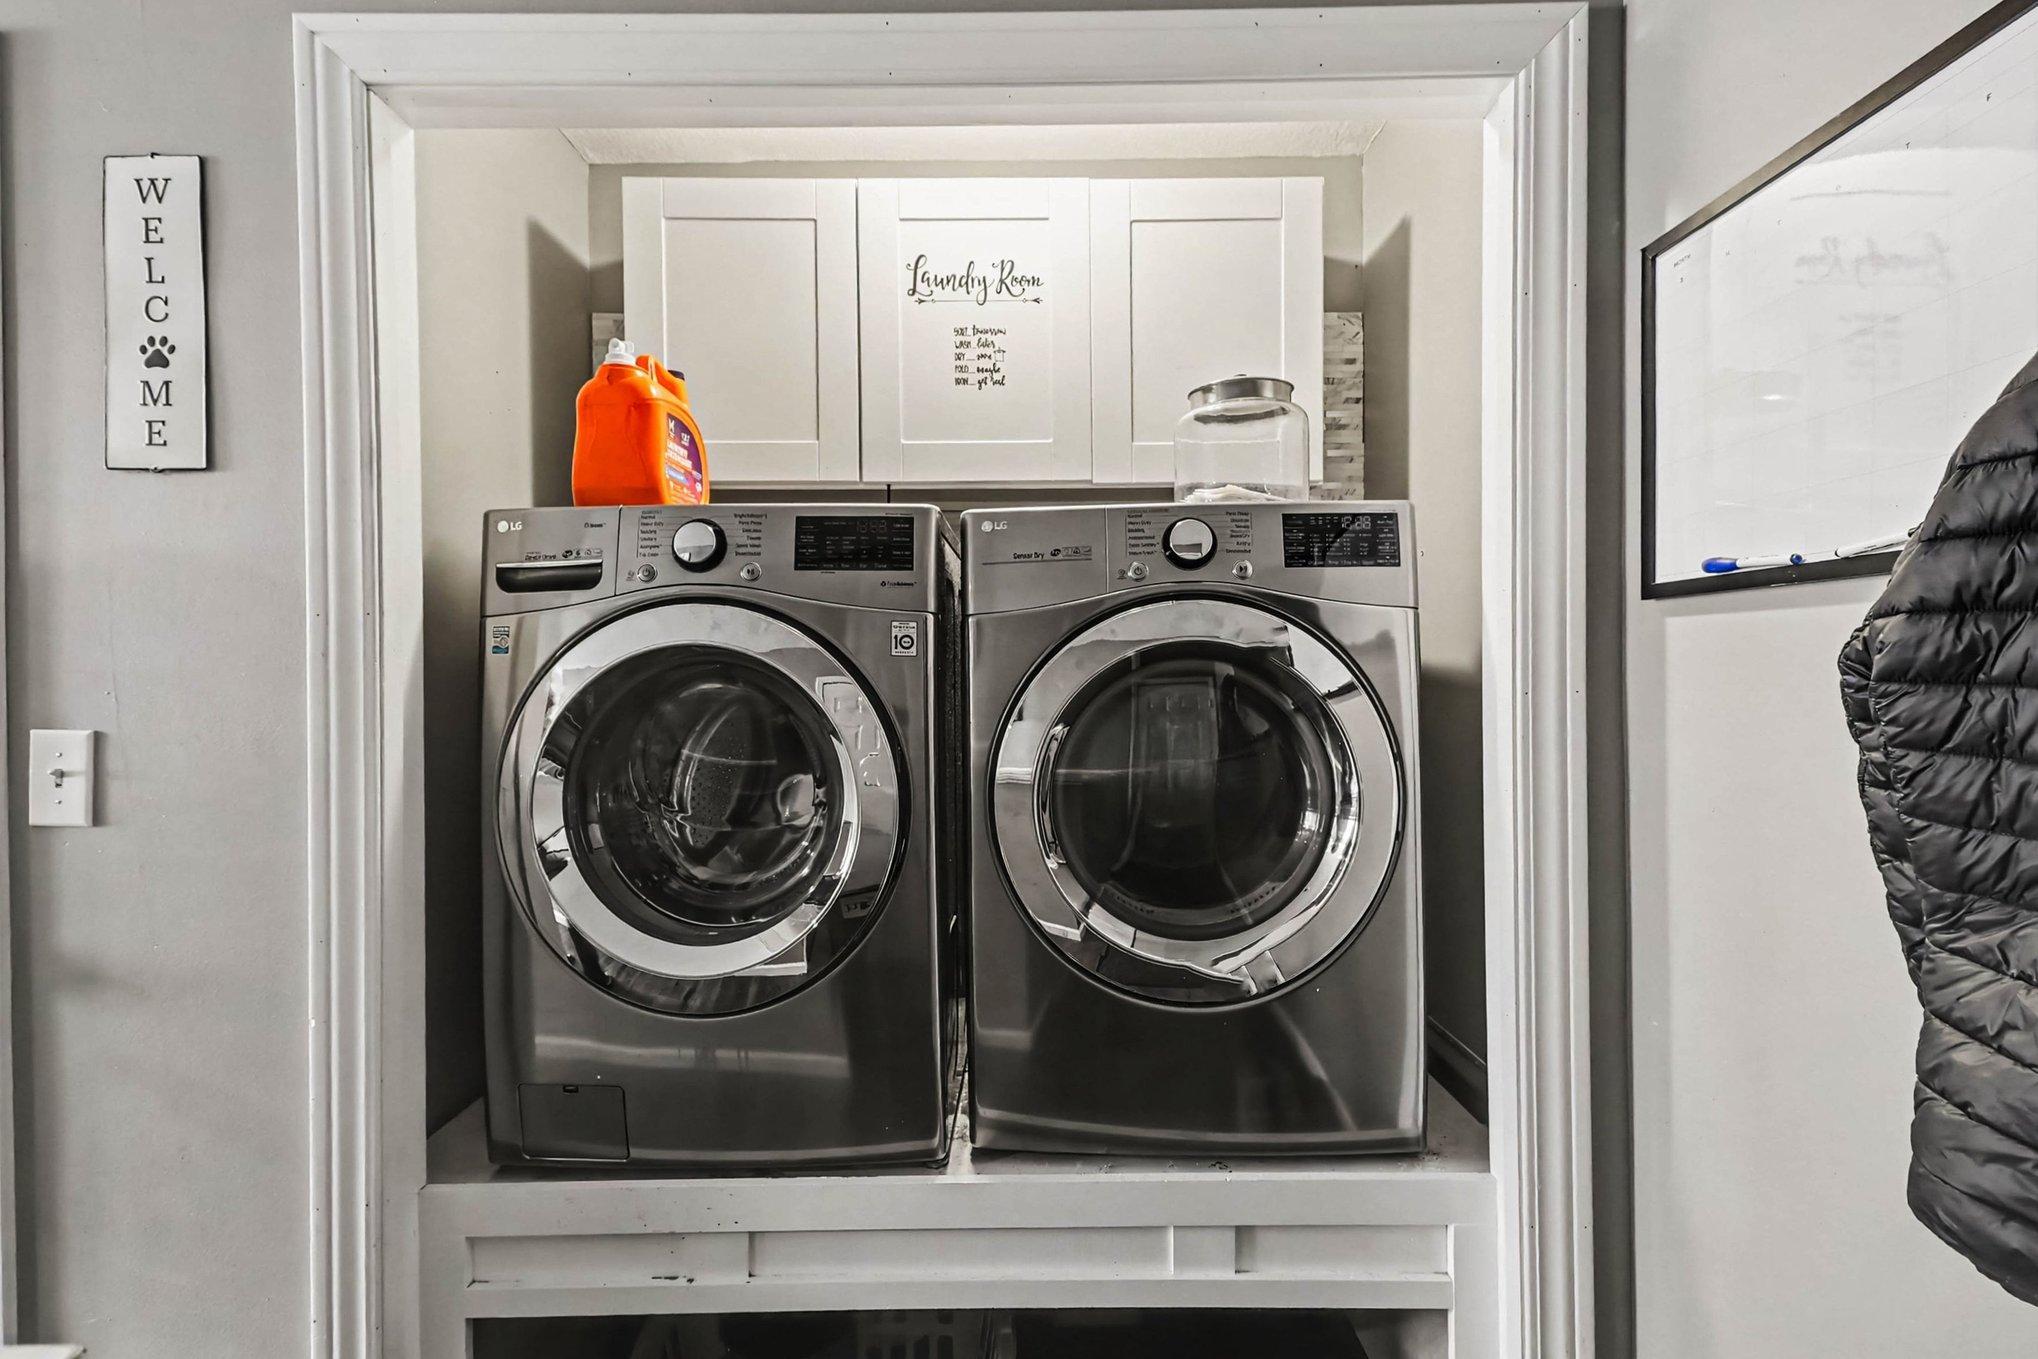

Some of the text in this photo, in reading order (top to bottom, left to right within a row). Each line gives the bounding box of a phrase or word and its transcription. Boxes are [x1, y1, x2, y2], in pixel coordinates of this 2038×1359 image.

[906, 254, 1045, 306] Laundry Room
[133, 178, 174, 447] WELCME
[977, 362, 1001, 379] maybe
[510, 521, 522, 531] LG
[994, 521, 1008, 530] LG
[1013, 552, 1045, 560] Sensor Dry
